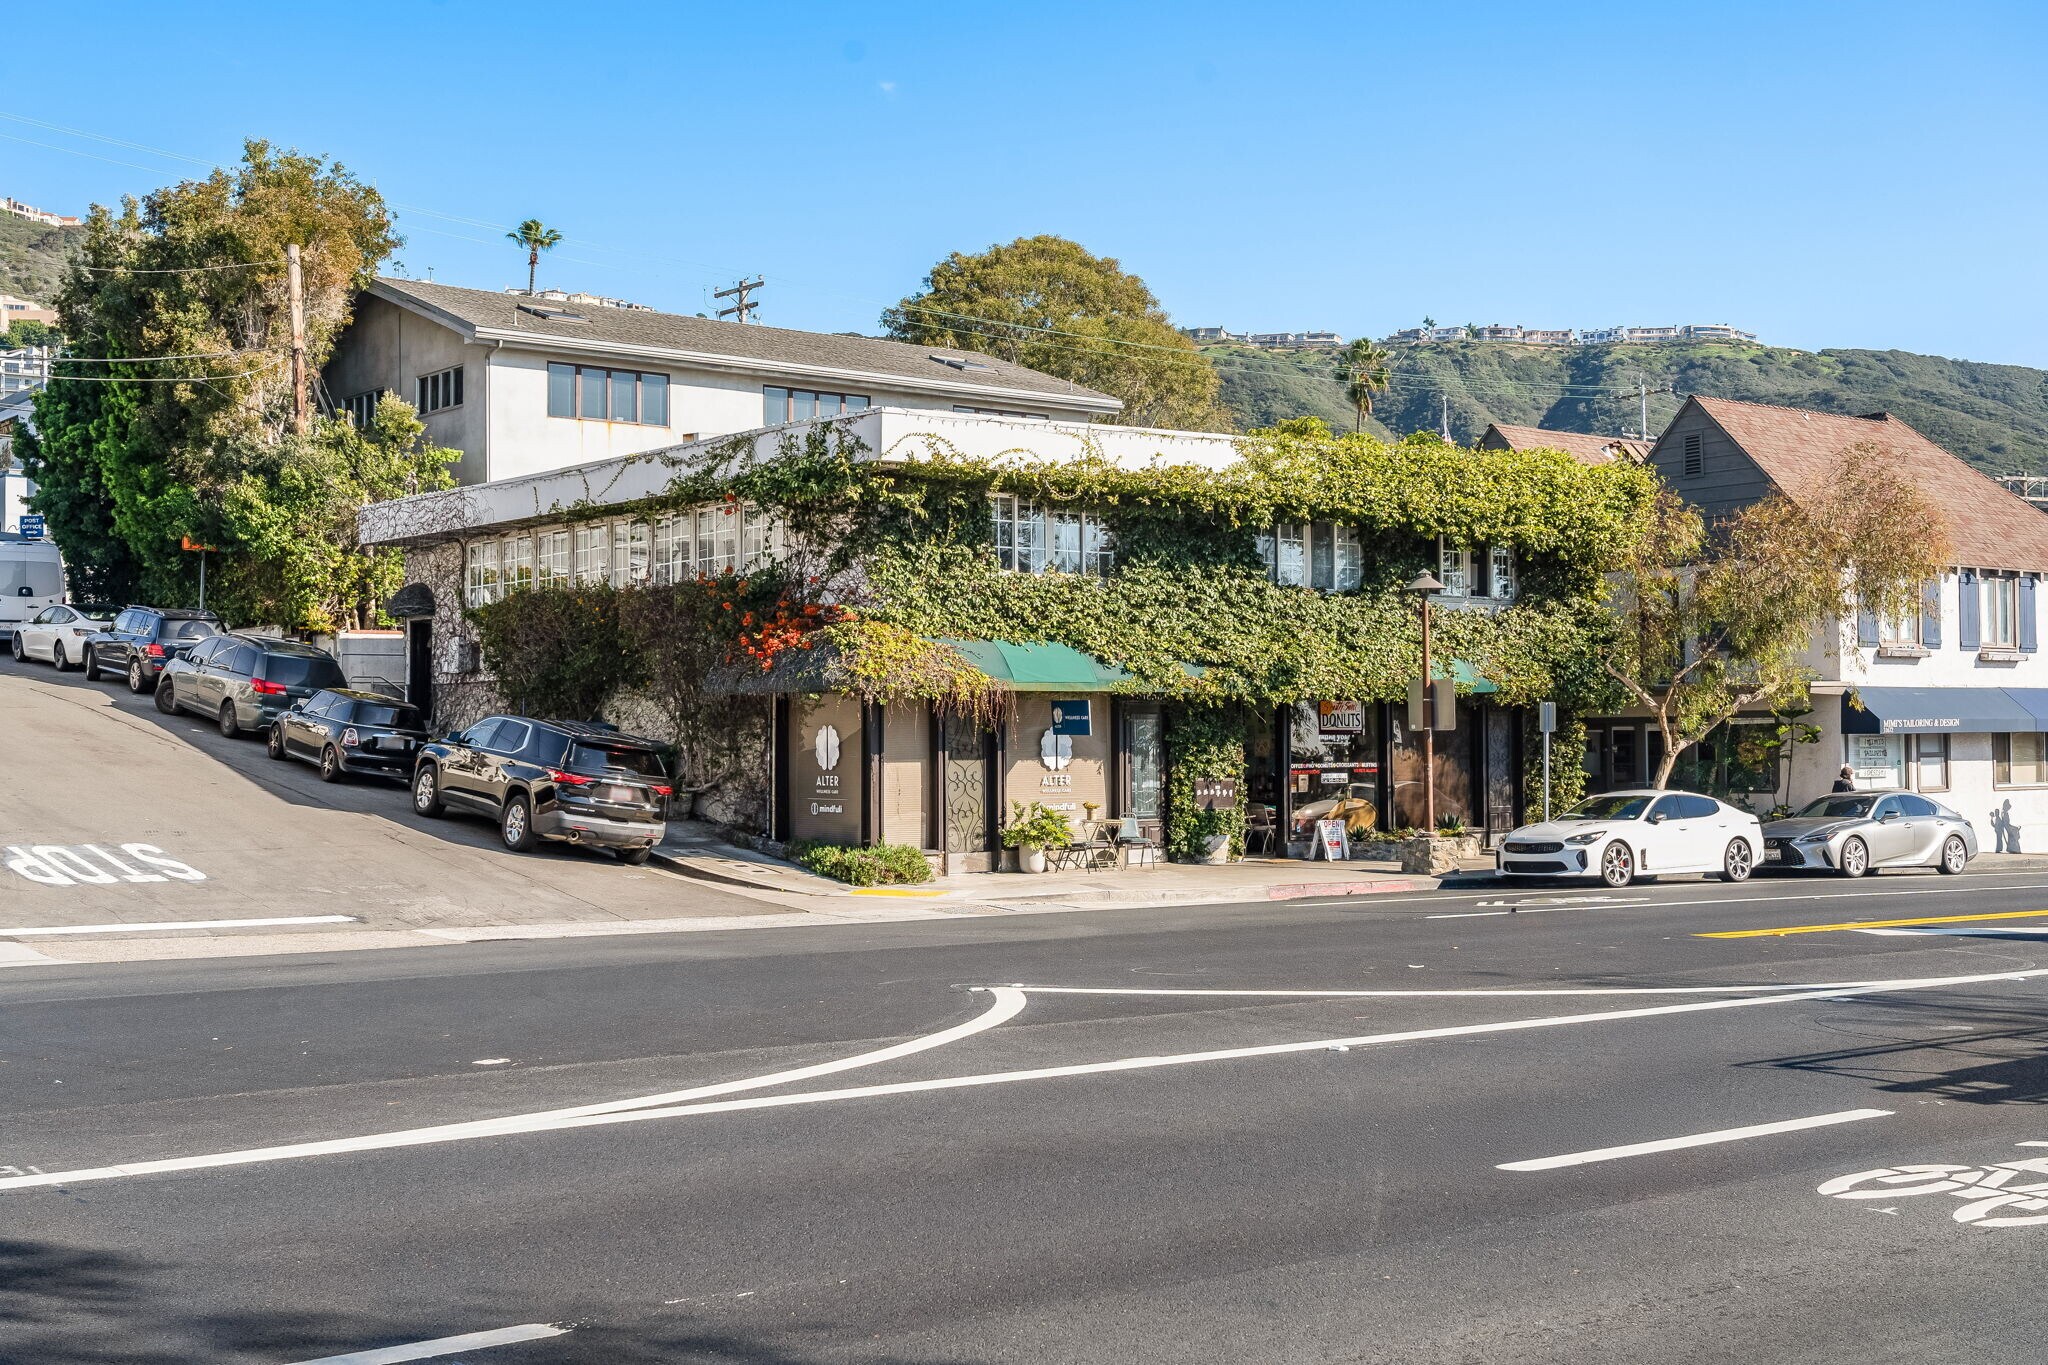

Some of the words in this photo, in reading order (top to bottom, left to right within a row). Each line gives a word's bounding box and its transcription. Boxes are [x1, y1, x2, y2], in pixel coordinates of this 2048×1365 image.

[1322, 713, 1361, 727] DONUTS
[1883, 719, 1903, 728] MIMI'S
[1903, 718, 1933, 728] TAILORING
[1934, 718, 1939, 727] &
[1939, 718, 1960, 727] DESIGN
[816, 775, 839, 786] ALTER
[1042, 774, 1071, 786] ALTER
[1323, 820, 1340, 828] OPEN
[6, 843, 207, 885] STOP
